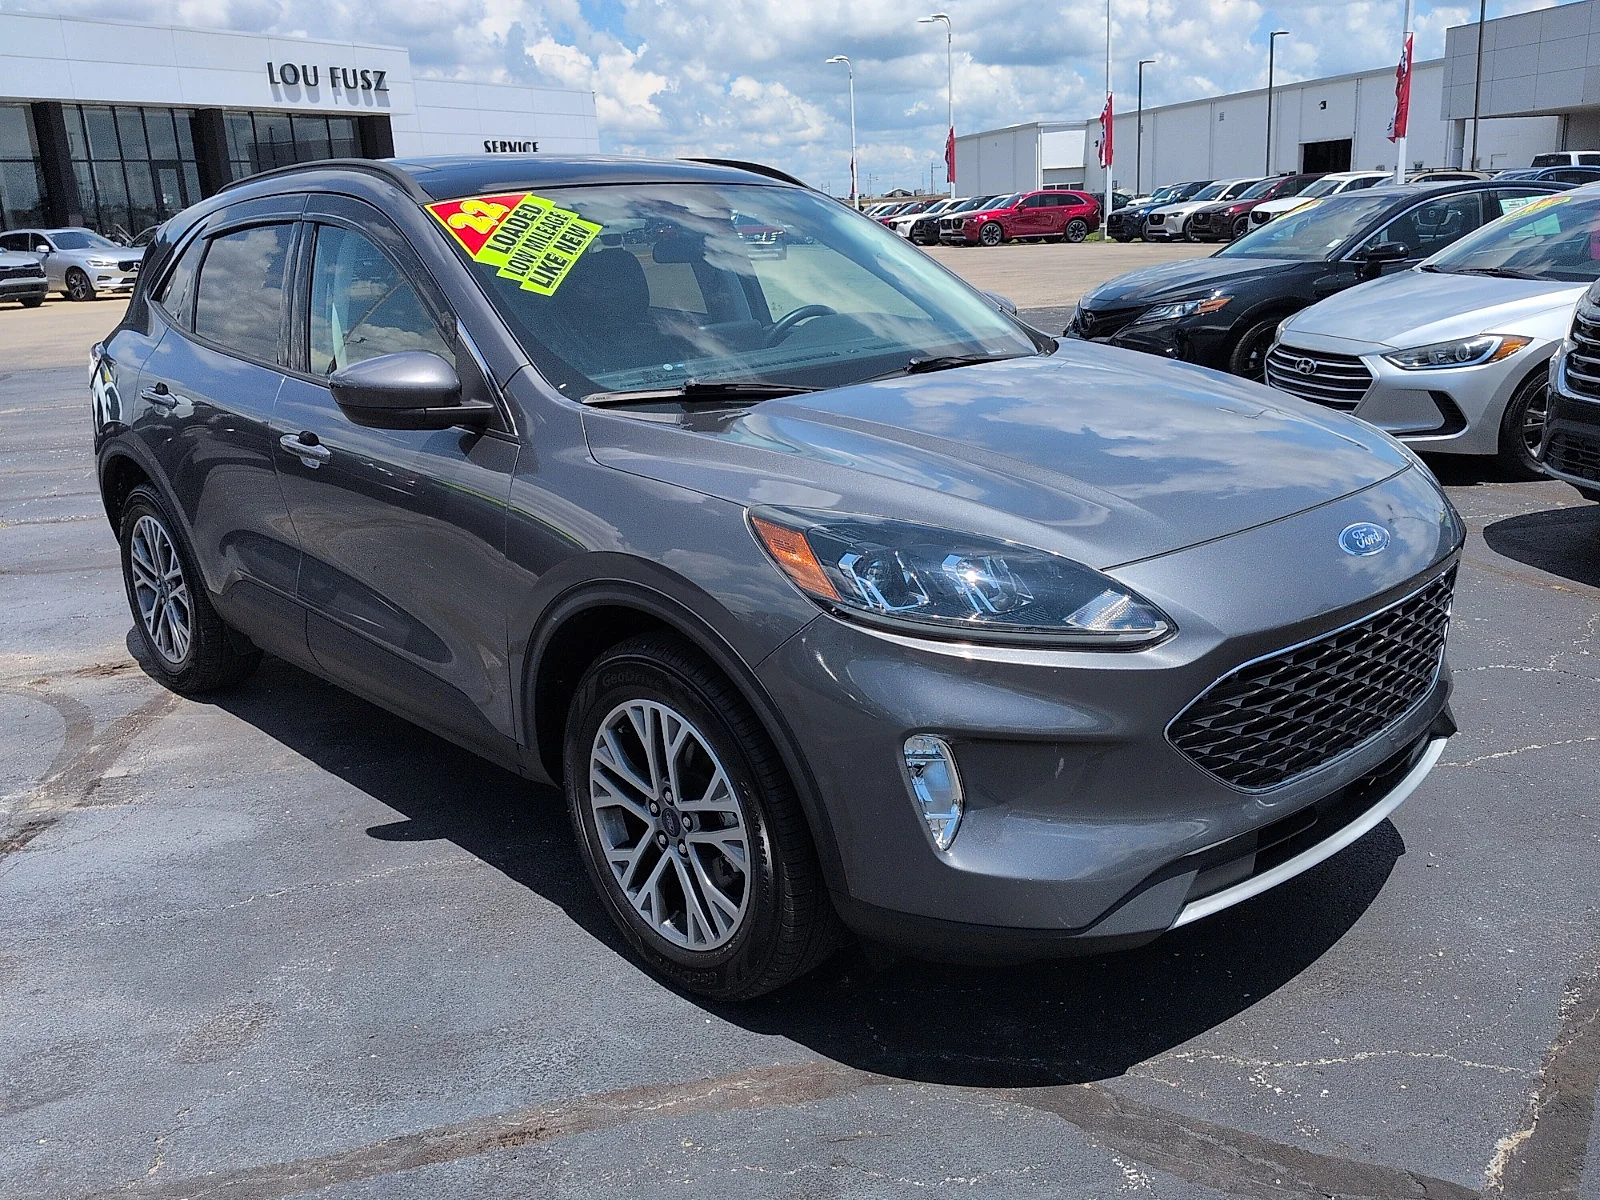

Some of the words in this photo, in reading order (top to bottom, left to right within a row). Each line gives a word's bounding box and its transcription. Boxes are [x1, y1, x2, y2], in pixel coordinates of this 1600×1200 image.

[267, 61, 319, 87] LOU
[329, 66, 390, 91] FUSZ
[483, 140, 540, 153] SERVICE
[485, 203, 543, 254] LOADED
[503, 248, 538, 276] LOW
[522, 211, 570, 254] MILEAGE
[527, 252, 568, 289] LIKE
[553, 223, 591, 255] NEW
[1353, 528, 1381, 548] Ford
